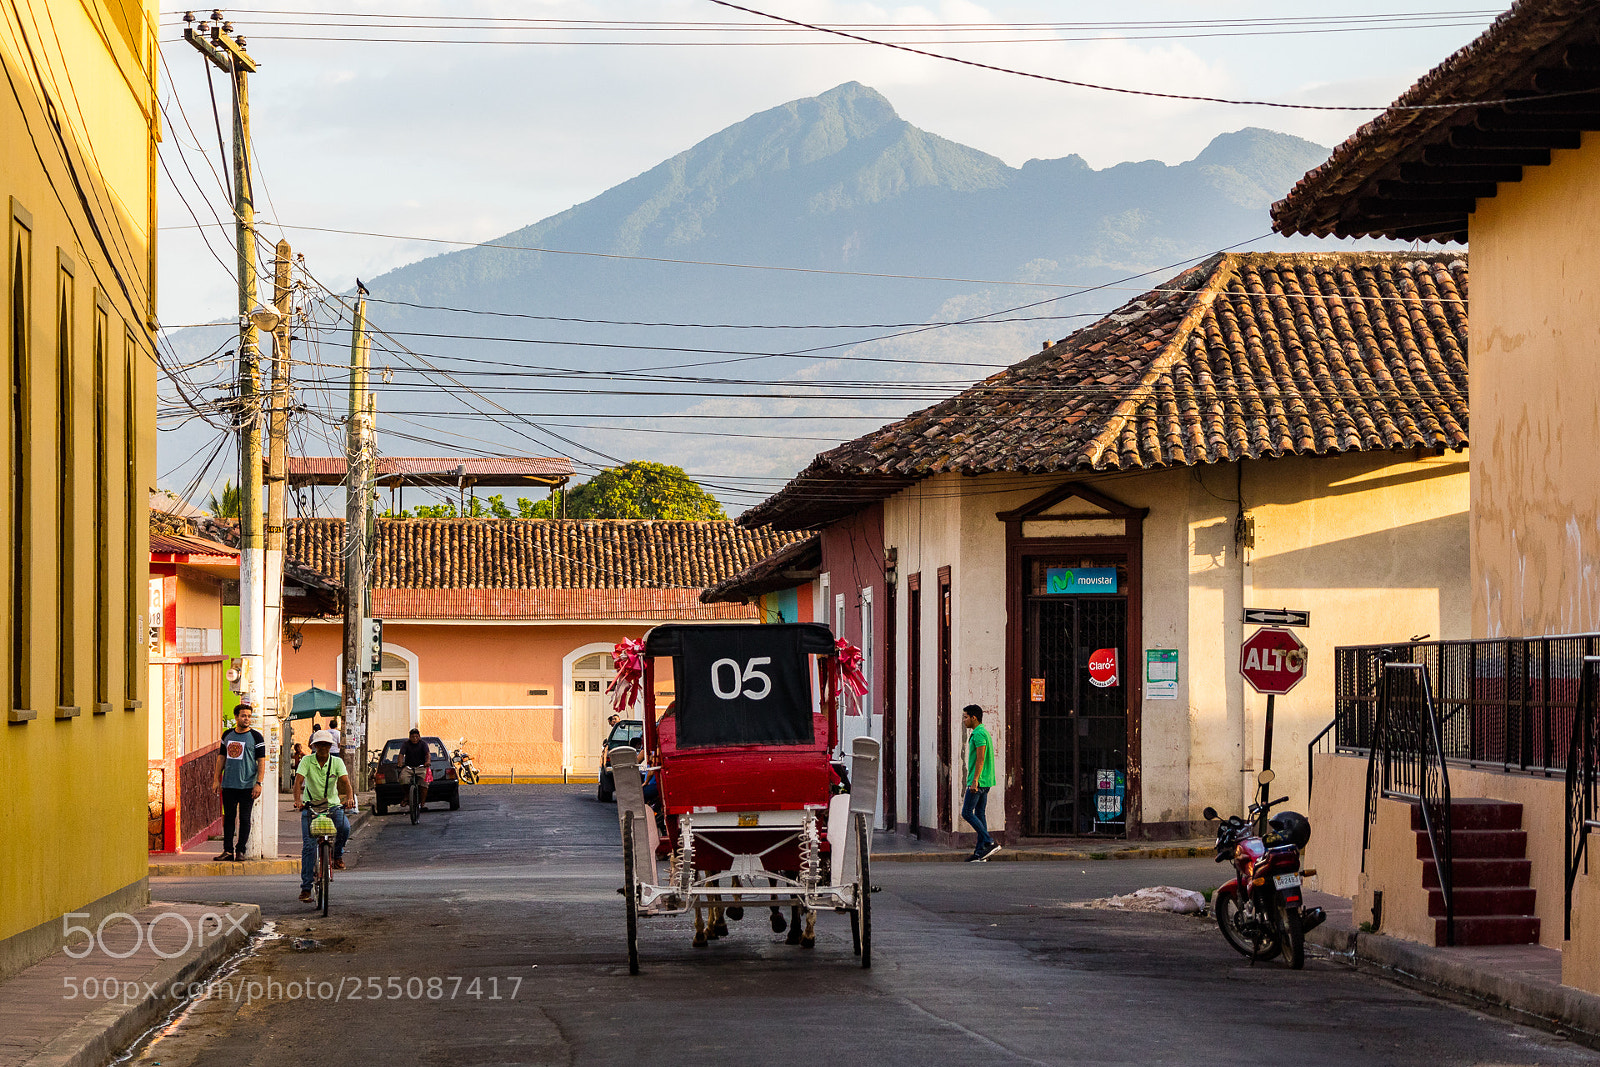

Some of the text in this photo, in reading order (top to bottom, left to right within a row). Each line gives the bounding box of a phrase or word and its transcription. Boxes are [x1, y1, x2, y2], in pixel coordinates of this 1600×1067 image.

[1077, 576, 1113, 585] movistar
[1089, 660, 1111, 671] Claro
[1244, 647, 1302, 673] ALTO
[711, 656, 772, 700] 05
